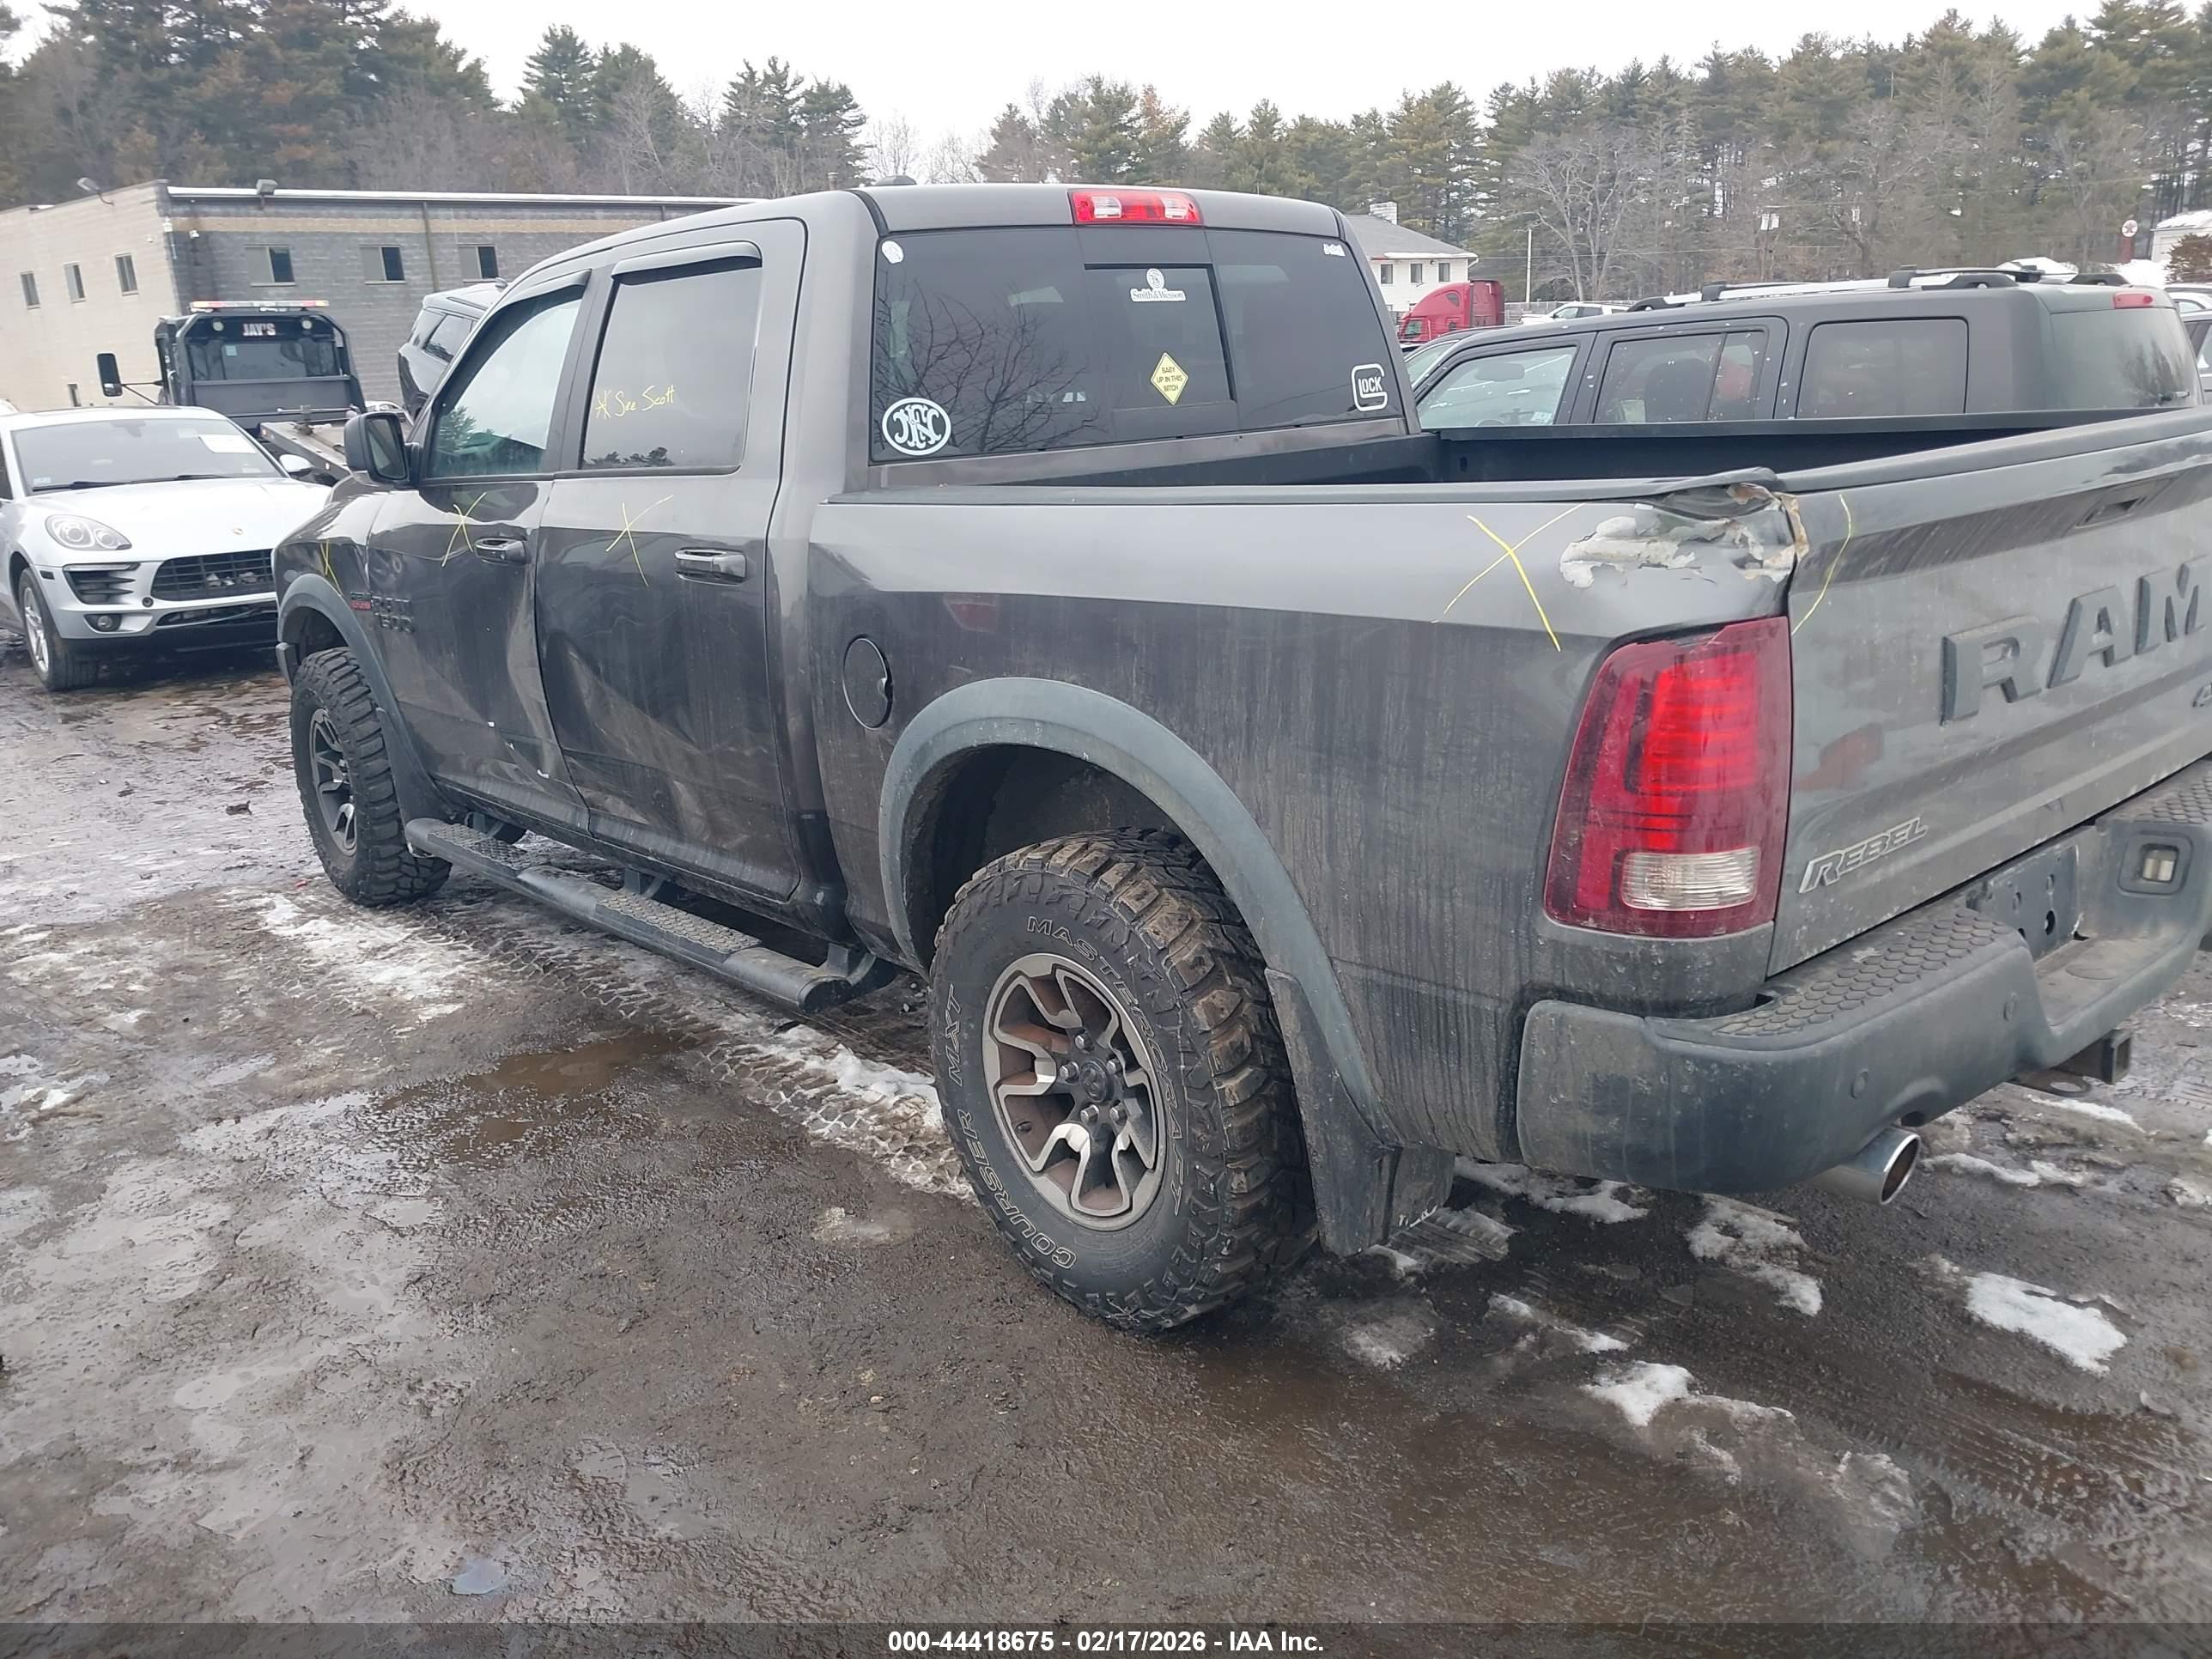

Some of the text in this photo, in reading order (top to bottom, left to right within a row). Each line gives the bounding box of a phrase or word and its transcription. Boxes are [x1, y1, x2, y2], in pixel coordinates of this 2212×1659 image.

[243, 323, 276, 336] JAY'S
[615, 385, 674, 416] See Scott
[1941, 555, 2212, 726] RAM
[1799, 817, 1929, 893] REBEL
[945, 983, 1078, 1270] COURSER MXT
[1028, 916, 1184, 1216] MASTERCRAFT
